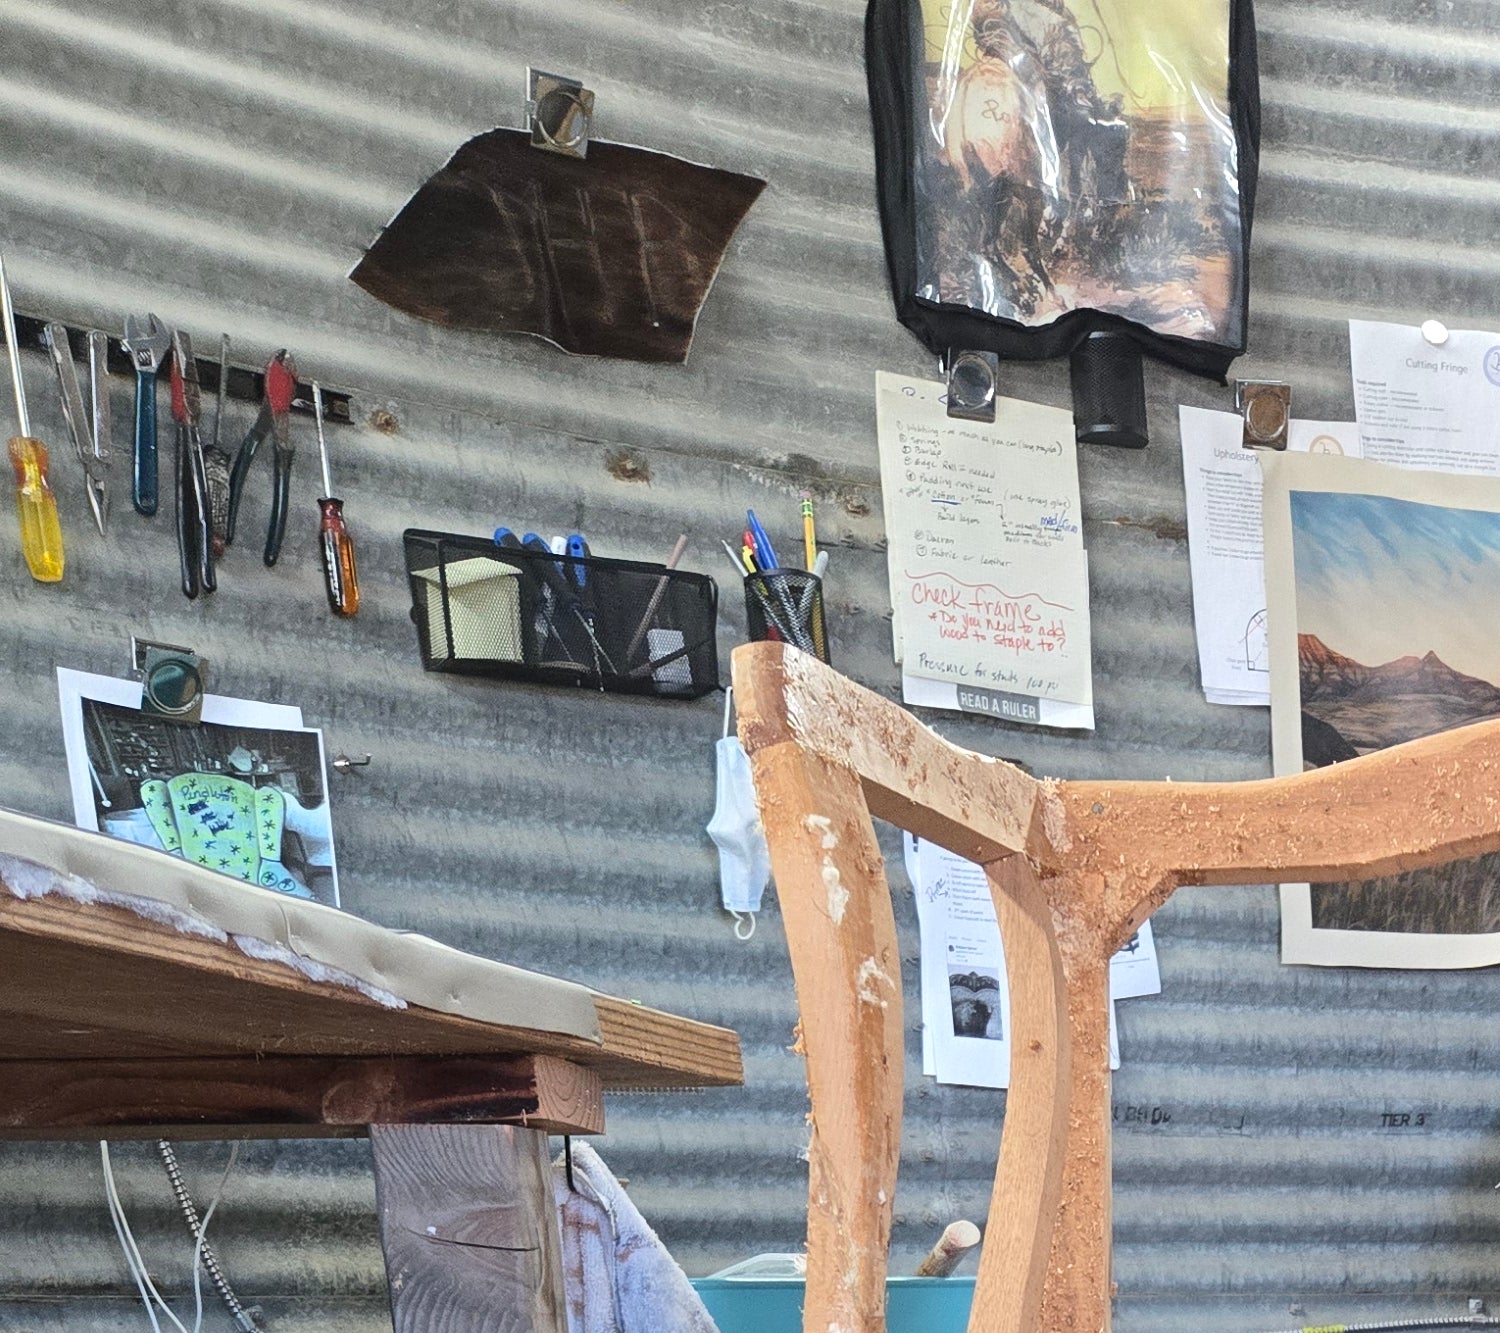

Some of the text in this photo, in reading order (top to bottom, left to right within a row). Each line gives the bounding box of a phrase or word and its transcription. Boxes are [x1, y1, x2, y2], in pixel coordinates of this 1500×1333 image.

[1405, 358, 1469, 375] Cutting Fringe
[1214, 448, 1259, 464] Upholstery
[939, 610, 1066, 638] Do you need to add
[972, 632, 986, 643] to
[919, 652, 968, 676] Pressure
[974, 662, 986, 678] for
[960, 691, 1037, 720] READ A RULER
[1380, 1113, 1426, 1127] TIER 3
